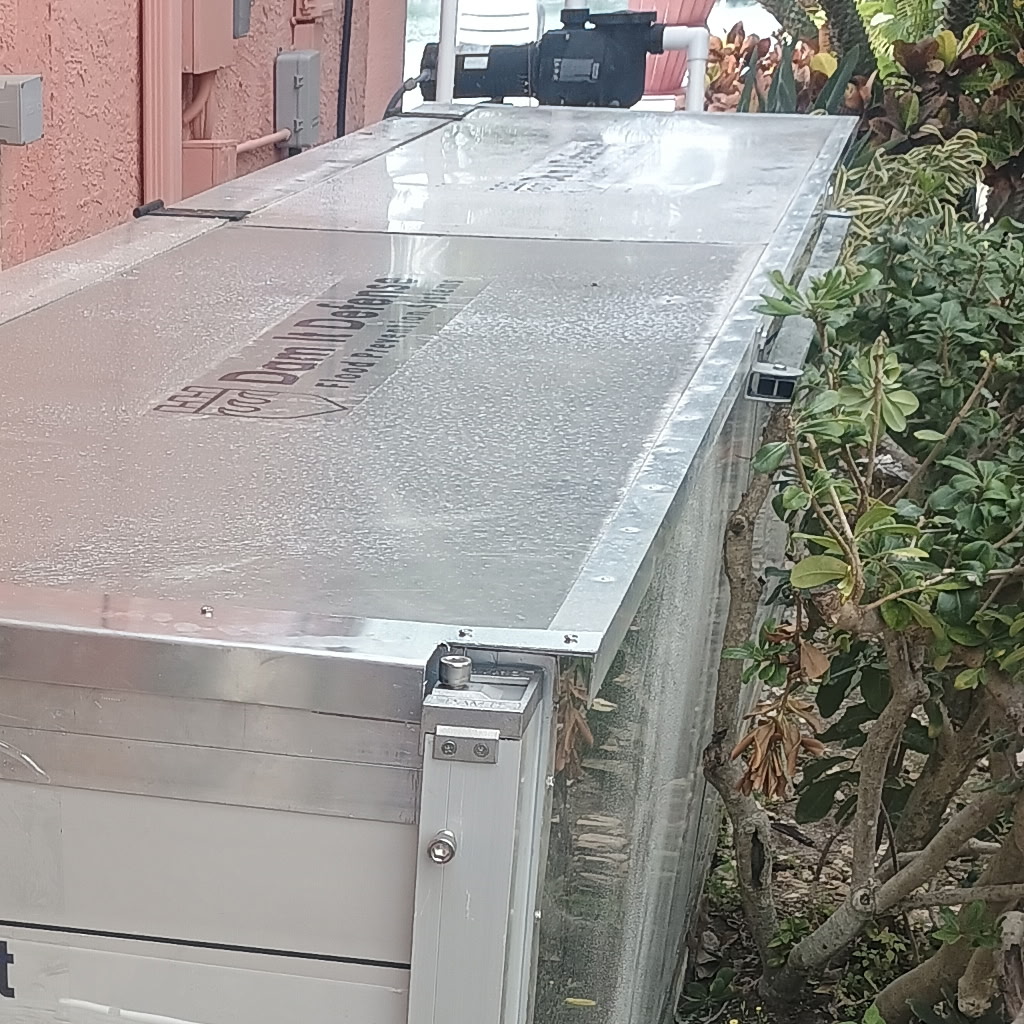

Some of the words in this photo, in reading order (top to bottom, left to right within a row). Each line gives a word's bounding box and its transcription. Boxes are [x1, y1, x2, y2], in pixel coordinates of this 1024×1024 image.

[218, 345, 336, 386] Dam
[293, 276, 418, 330] Defense
[314, 360, 376, 389] Flood
